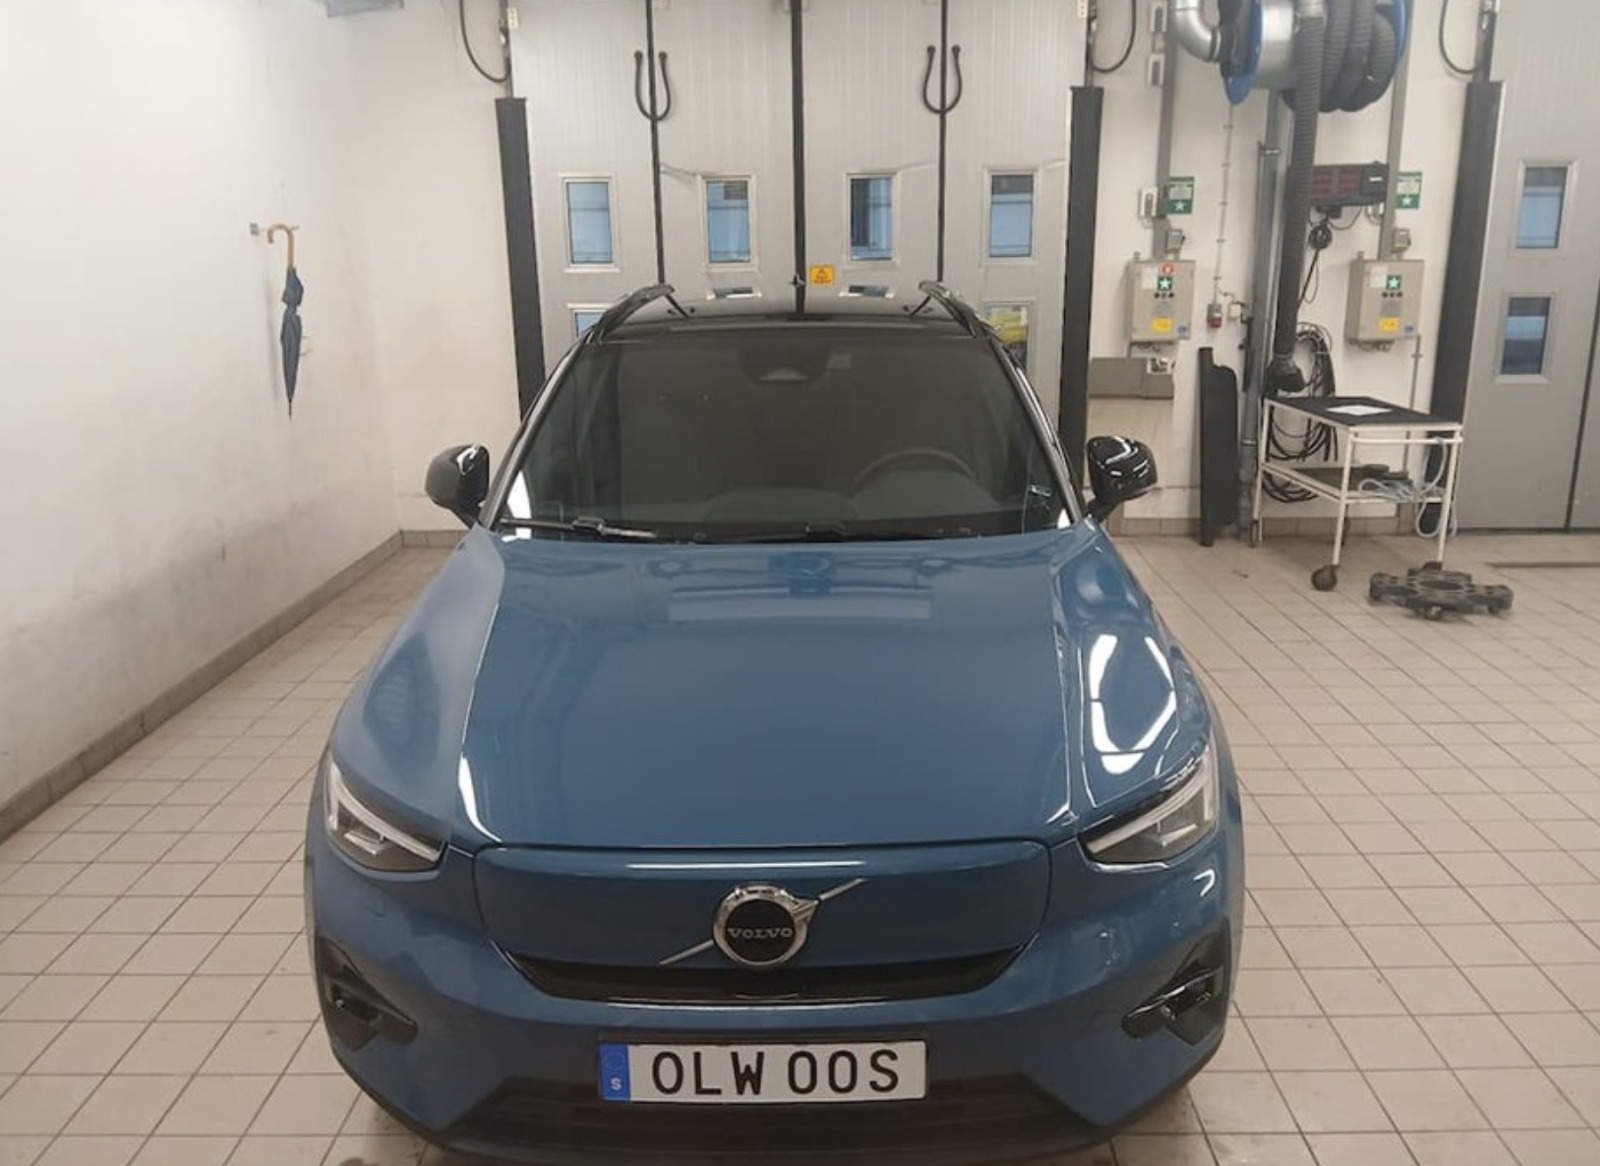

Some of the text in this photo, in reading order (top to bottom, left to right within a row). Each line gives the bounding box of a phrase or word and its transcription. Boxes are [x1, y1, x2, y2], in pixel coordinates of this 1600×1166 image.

[727, 927, 793, 939] VOLVO
[652, 1050, 765, 1095] OLW
[610, 1077, 623, 1091] S
